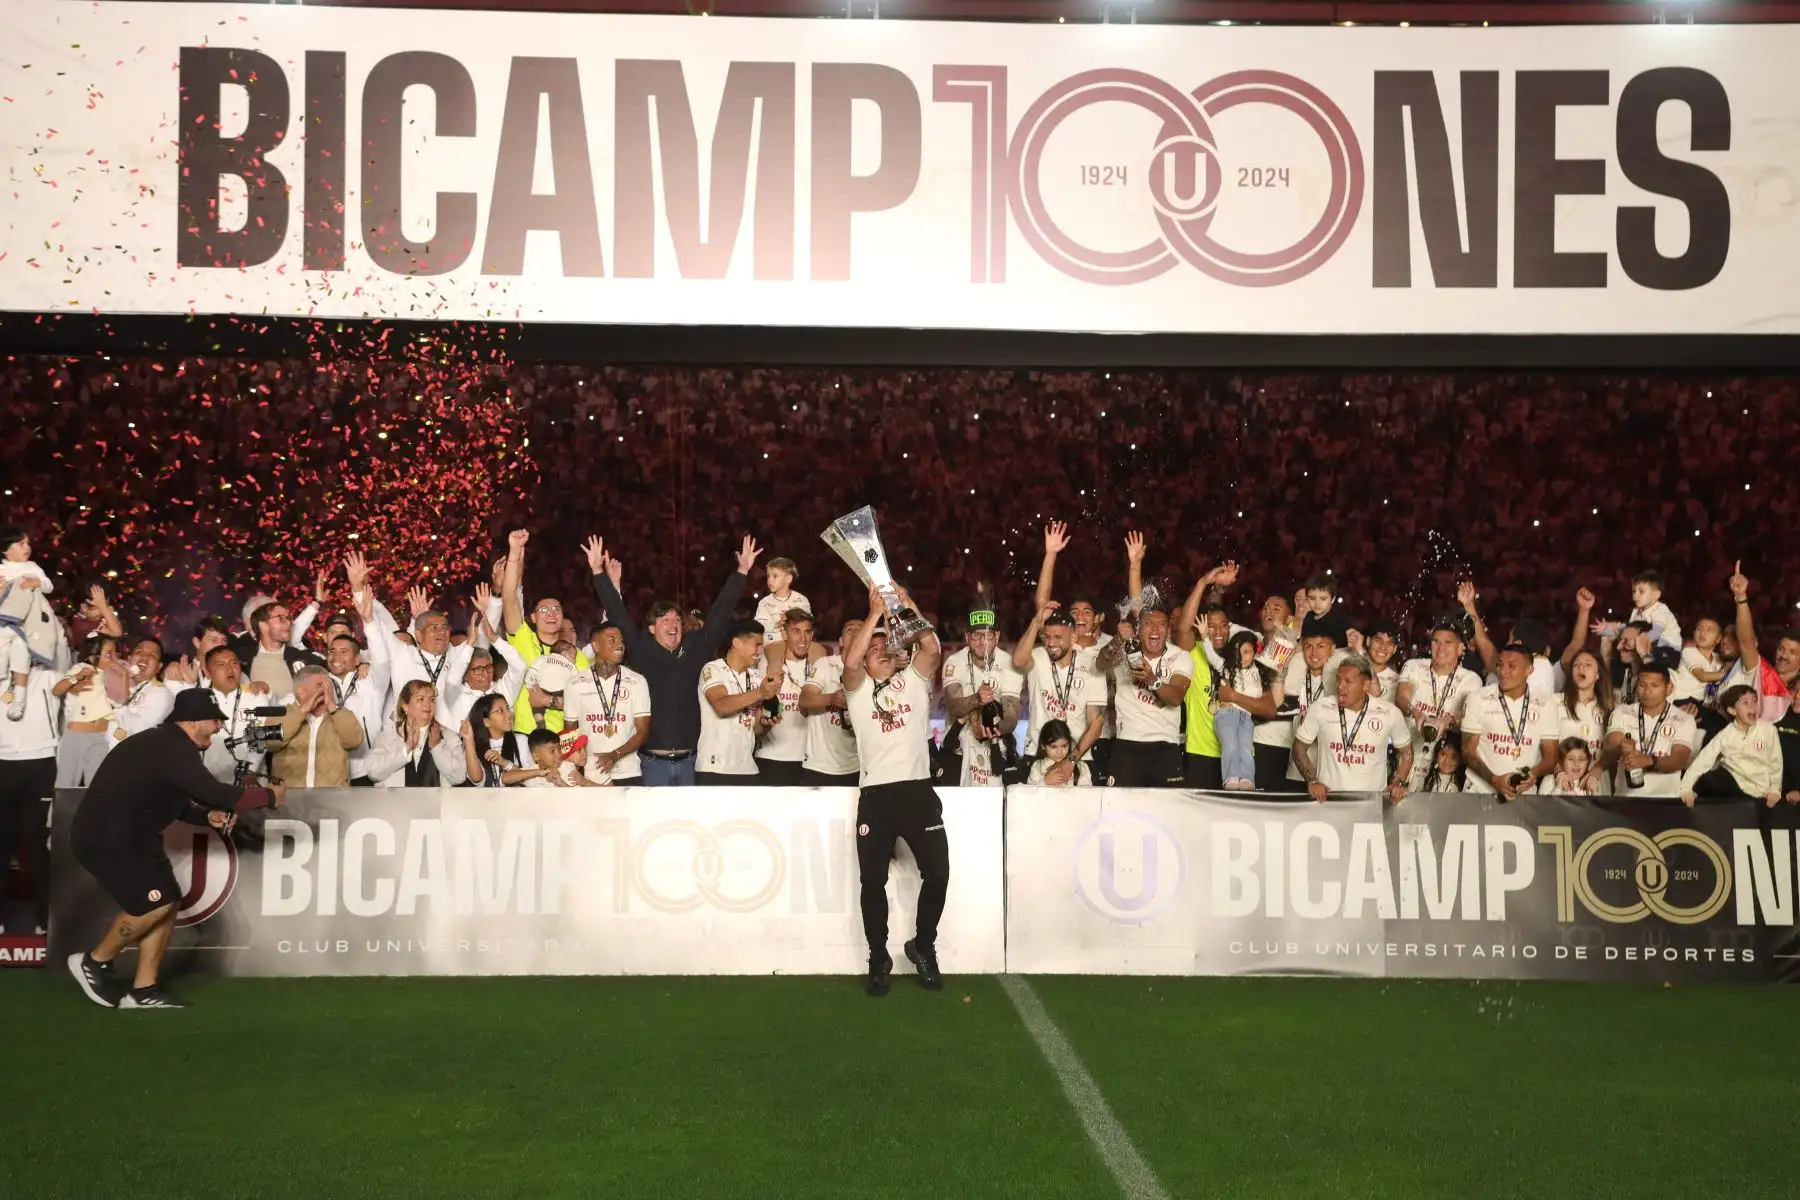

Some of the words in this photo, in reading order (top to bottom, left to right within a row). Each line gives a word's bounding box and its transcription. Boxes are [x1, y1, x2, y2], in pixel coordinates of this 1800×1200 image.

[1080, 165, 1128, 186] 1924
[1237, 167, 1290, 187] 2024
[1042, 689, 1076, 711] apueta
[872, 703, 912, 721] aeta
[1047, 702, 1067, 718] toal
[586, 712, 627, 724] apusta
[592, 724, 618, 734] tol
[1487, 731, 1532, 745] apueta
[1330, 742, 1376, 753] apesta
[1493, 744, 1516, 756] tot
[1210, 820, 1800, 926] BICAMP100N
[1604, 868, 1627, 880] 1924
[1674, 870, 1699, 881] 2024
[277, 940, 349, 953] CLUB
[1229, 941, 1299, 955] CLUB
[1315, 941, 1538, 958] UNIVERSITARIO
[1555, 946, 1588, 960] DE
[1605, 946, 1755, 962] DEPORTES
